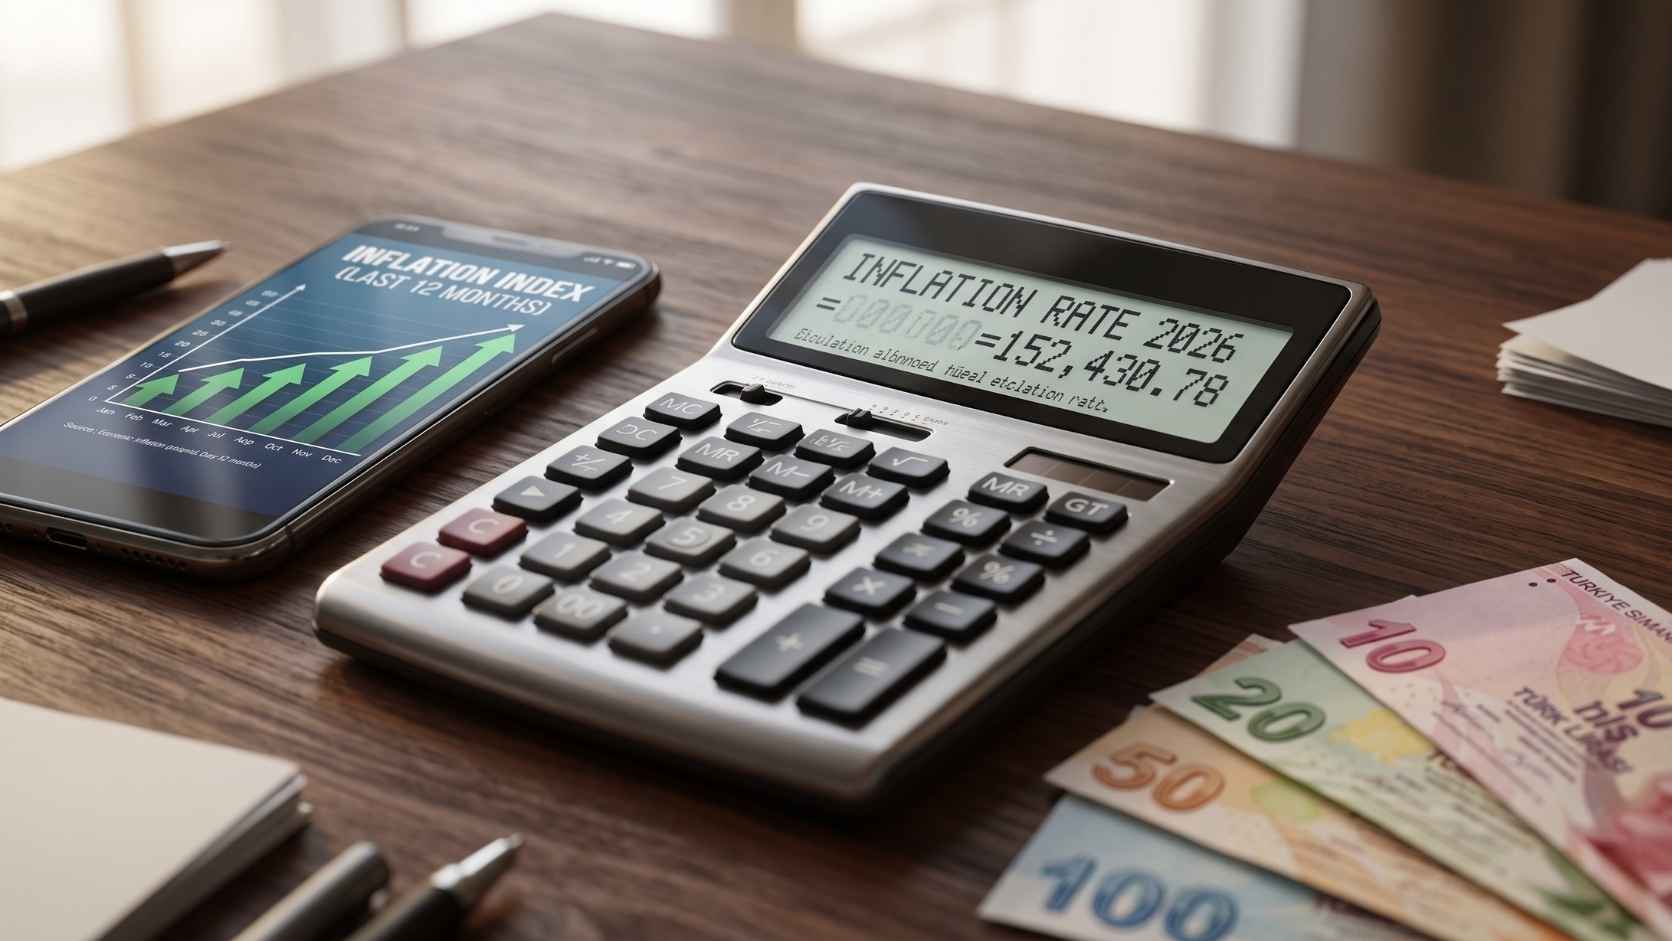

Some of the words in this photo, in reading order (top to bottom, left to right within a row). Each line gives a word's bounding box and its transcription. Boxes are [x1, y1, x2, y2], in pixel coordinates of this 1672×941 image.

[341, 245, 500, 285] INFLATION
[494, 271, 595, 303] INDEX
[335, 266, 411, 290] (LAST
[410, 280, 442, 296] 12
[438, 284, 552, 315] MONTHS)
[843, 253, 1038, 318] INFLATION
[1040, 296, 1141, 340] RATE
[1143, 318, 1244, 363] 2026
[659, 398, 702, 416] MC
[291, 448, 313, 457] Nov
[321, 454, 343, 464] Dec
[696, 442, 739, 462] MR
[658, 475, 686, 491] 7
[839, 480, 883, 498] M+
[982, 477, 1030, 497] MR
[726, 494, 755, 512] 8
[1065, 498, 1109, 517] GT
[469, 518, 500, 534] C
[606, 508, 635, 525] 4
[801, 514, 830, 531] 9
[673, 527, 705, 545] 5
[410, 551, 441, 568] C
[554, 542, 577, 560] 1
[751, 550, 781, 567] 6
[621, 561, 651, 582] 2
[494, 575, 523, 594] 0
[693, 583, 726, 603] 3
[556, 592, 597, 620] 00
[1339, 619, 1446, 673] 10
[1192, 676, 1326, 743] 20
[1091, 742, 1225, 812] 50
[1038, 852, 1240, 941] 100
